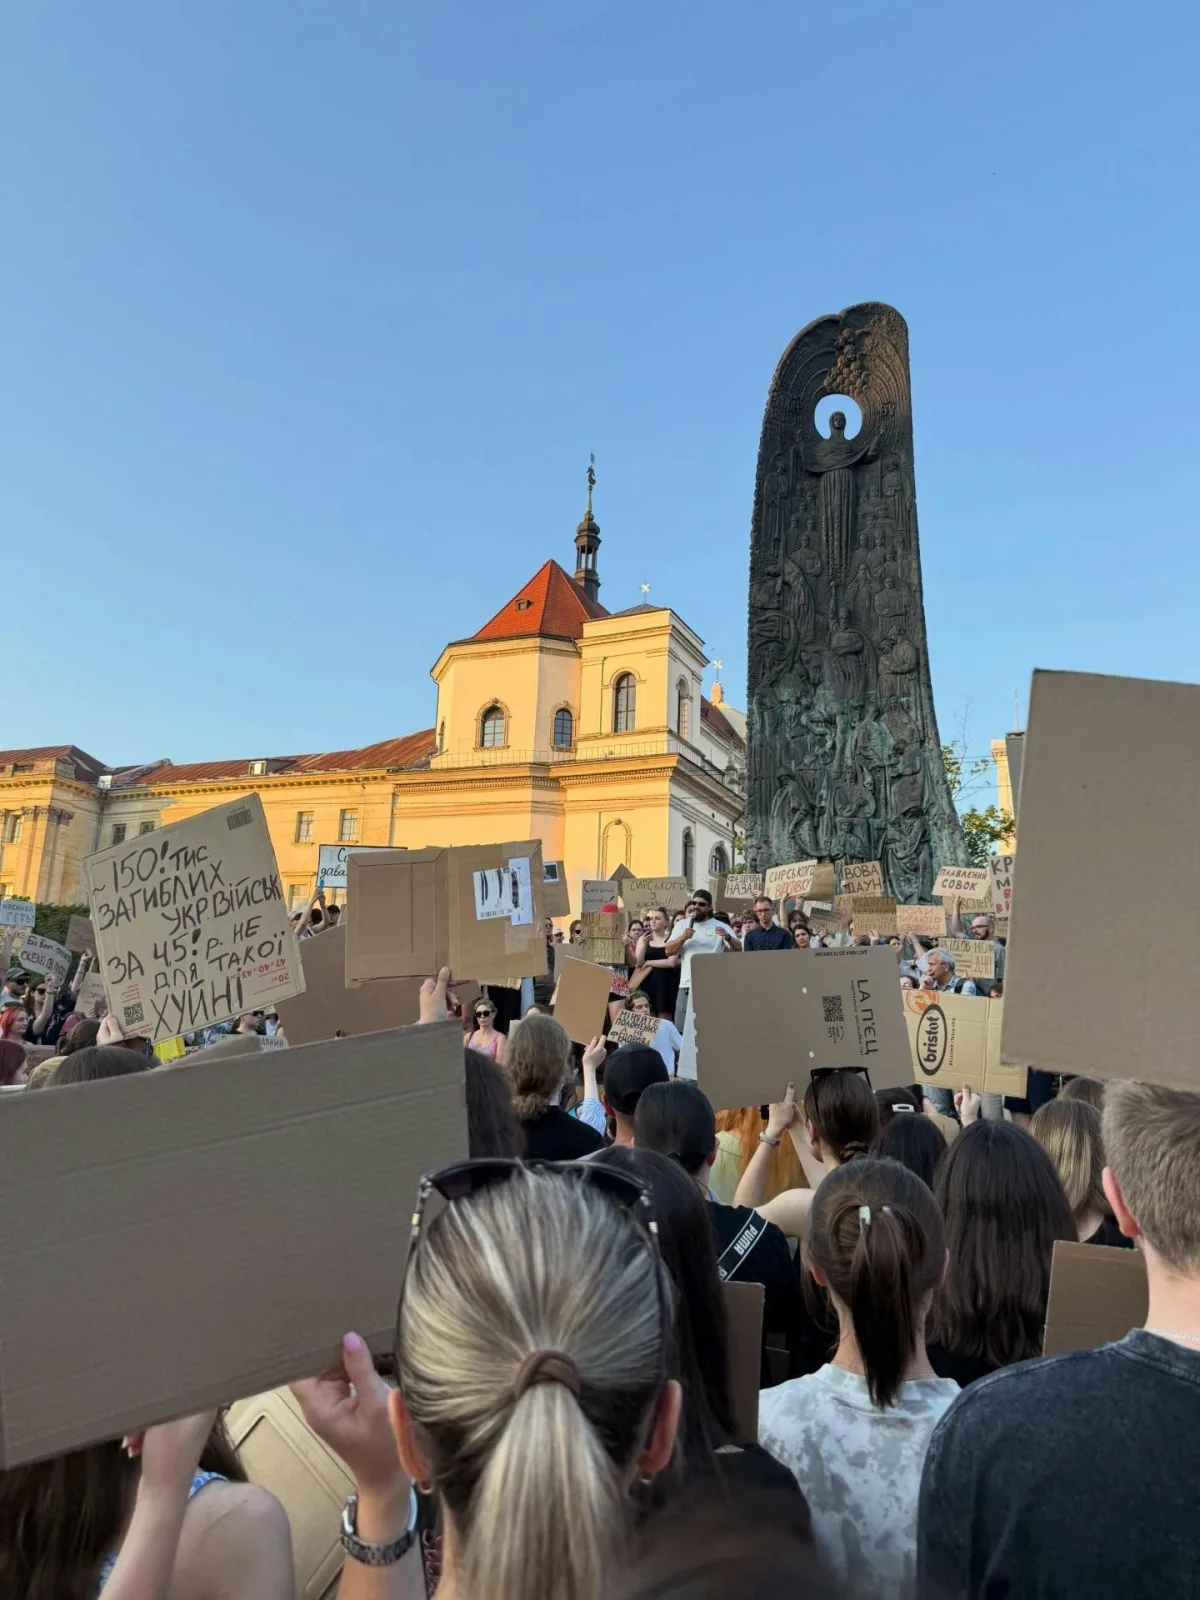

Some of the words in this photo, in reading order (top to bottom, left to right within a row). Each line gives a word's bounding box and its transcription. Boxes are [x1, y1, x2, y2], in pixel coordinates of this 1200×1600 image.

[320, 865, 347, 880] дава
[844, 864, 879, 880] ВОВА
[940, 868, 988, 880] ПЛАВЛЕНИЙ
[848, 878, 882, 894] ДАУН
[941, 879, 978, 891] СОВОК
[99, 860, 225, 930] ЗАГИБЛИХ
[108, 950, 145, 984] ЗА
[233, 915, 263, 942] НЕ
[154, 963, 198, 994] ДЛЯ
[208, 930, 286, 973] ТАКОЇ
[620, 1010, 660, 1025] МІНЯЙТЕ
[615, 1018, 657, 1034] ПОЛОНЕНИХ
[633, 1029, 643, 1037] НЕ
[923, 1016, 940, 1062] bristot
[733, 1224, 759, 1256] PUMA
